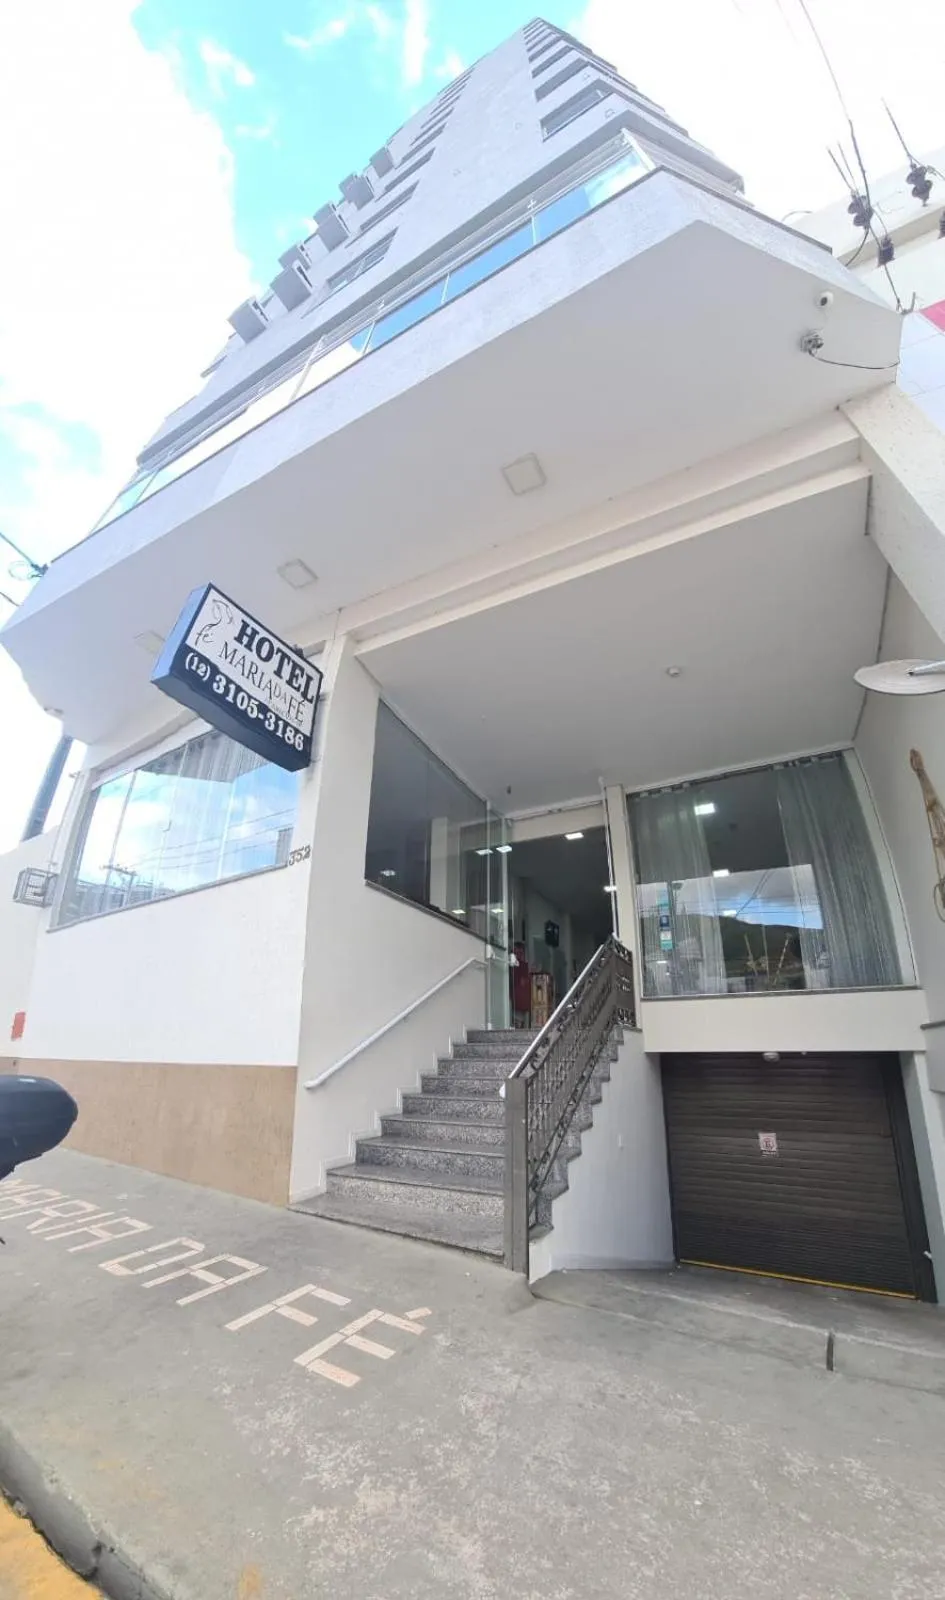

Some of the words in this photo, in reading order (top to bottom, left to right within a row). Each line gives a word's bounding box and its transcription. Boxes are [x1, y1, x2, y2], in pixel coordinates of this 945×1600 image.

[185, 652, 212, 681] (12)
[212, 674, 305, 751] 3105-3186
[218, 641, 273, 700] MARIA
[286, 695, 306, 723] FÉ
[234, 619, 314, 704] HOTEL
[289, 844, 311, 866] 352
[99, 1237, 269, 1305] DA
[224, 1283, 432, 1388] FÉ
